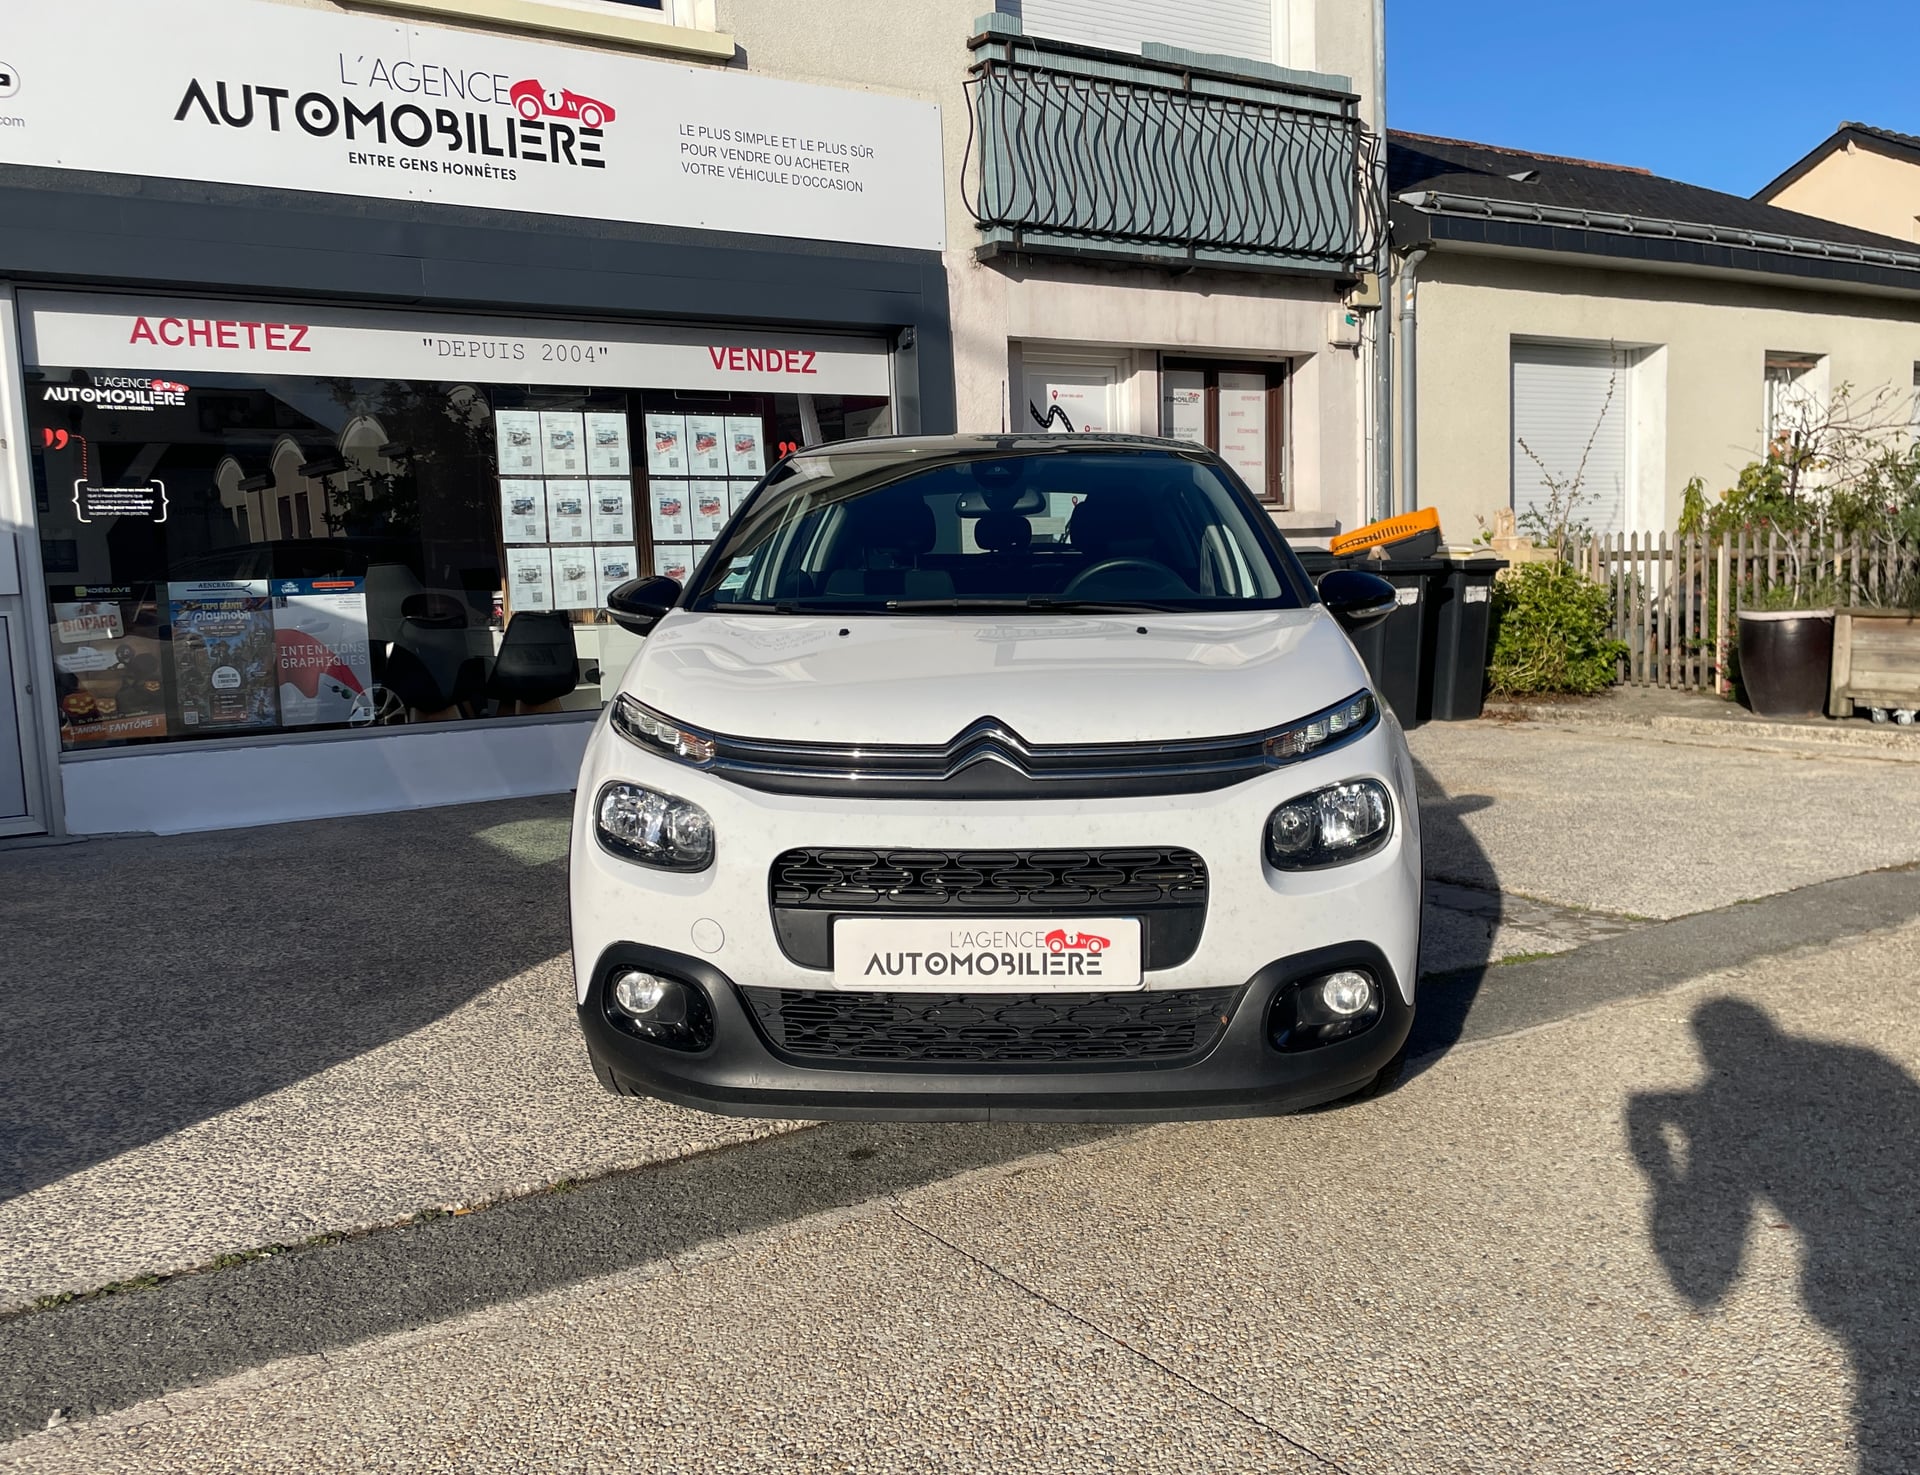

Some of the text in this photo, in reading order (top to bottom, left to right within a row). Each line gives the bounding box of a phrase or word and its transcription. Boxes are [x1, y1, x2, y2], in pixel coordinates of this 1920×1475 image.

[680, 123, 875, 159] LE PLUS SIMPLE ET LE PLUS SÛR
[348, 151, 517, 182] ENTRE GENS HONNÊTES
[681, 143, 850, 174] POUR VENDRE OU ACHETER
[681, 161, 864, 193] VOTRE VÉHICULE D'OCCASION
[129, 316, 312, 353] ACHETEZ
[422, 337, 609, 364] "DEPUIS 2004"
[707, 345, 817, 375] VENDEZ
[62, 613, 118, 633] BIOPARC
[280, 642, 366, 657] INTENTIONS
[281, 654, 367, 669] GRAPHIQUES
[109, 718, 153, 733] FANTÔME
[949, 930, 1046, 949] L'AGENCE
